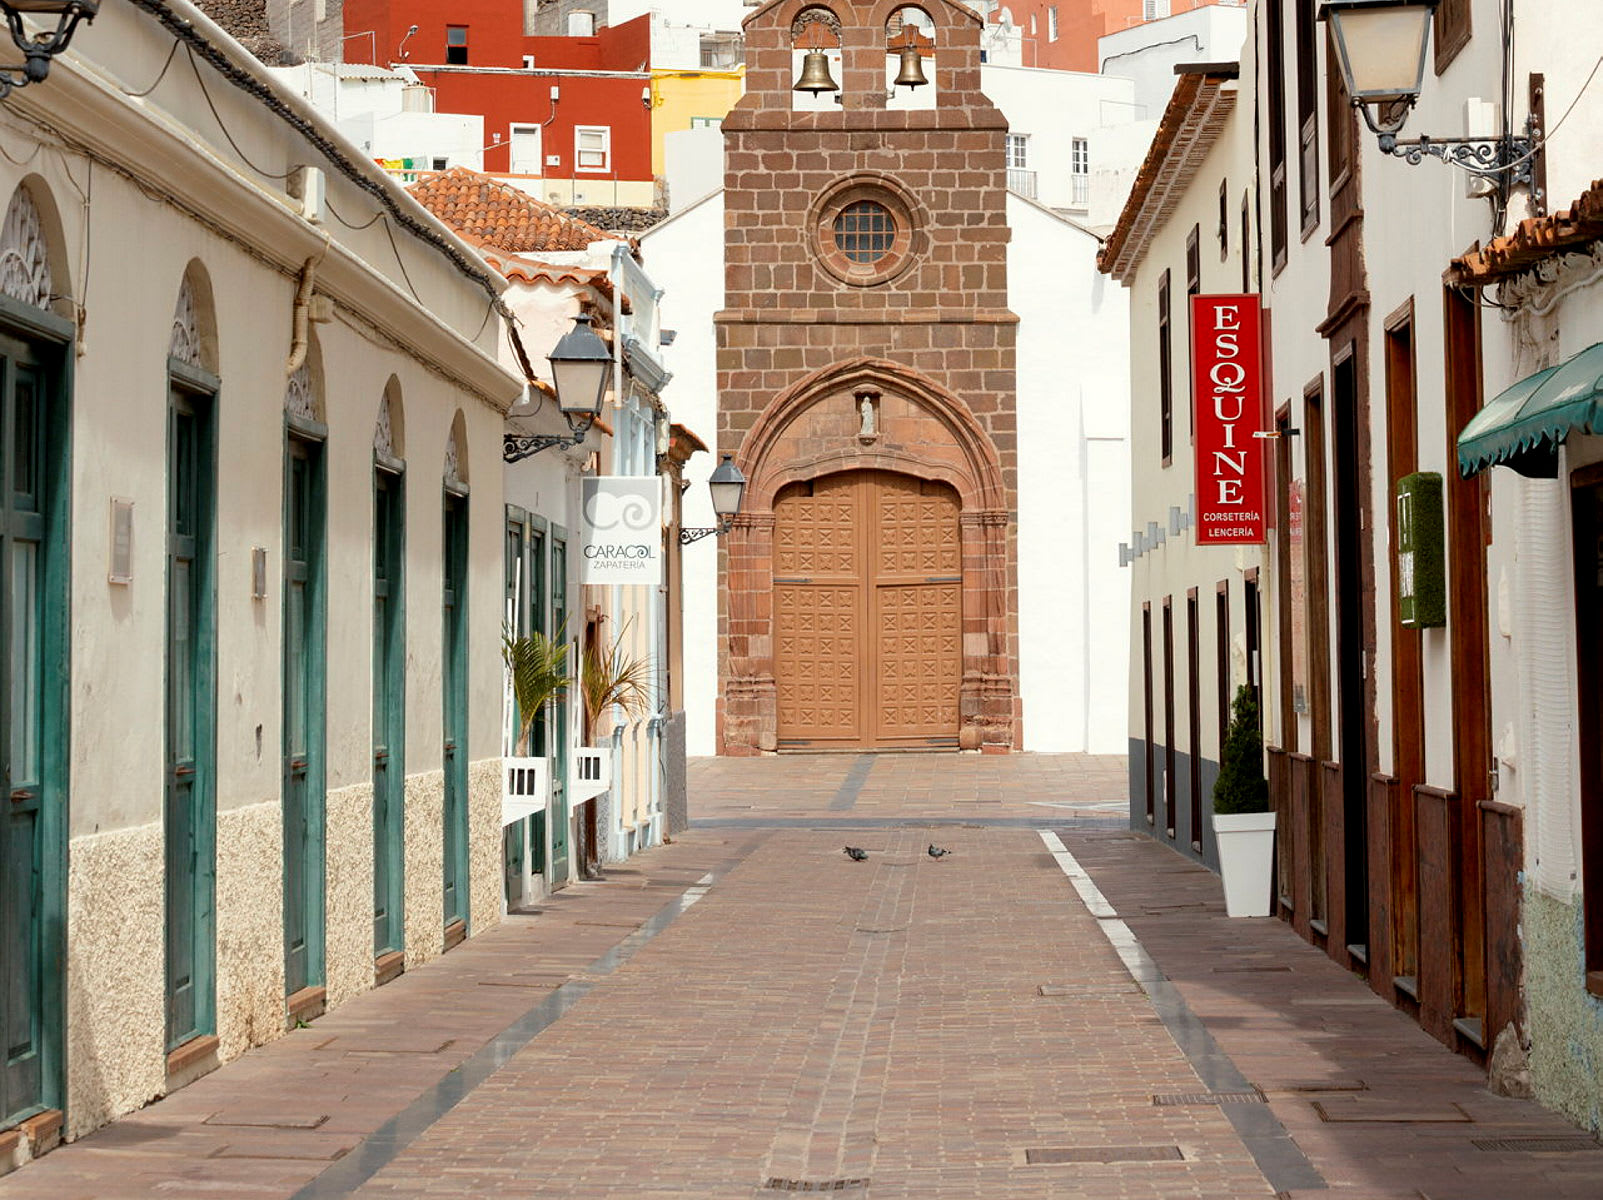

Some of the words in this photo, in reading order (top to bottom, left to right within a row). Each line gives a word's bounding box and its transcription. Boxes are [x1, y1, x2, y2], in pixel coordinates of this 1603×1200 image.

[1209, 305, 1247, 505] ESQUINE
[1203, 510, 1260, 521] CORSETERÍA
[1208, 526, 1254, 537] LENCERÍA
[583, 544, 656, 558] CARACOL
